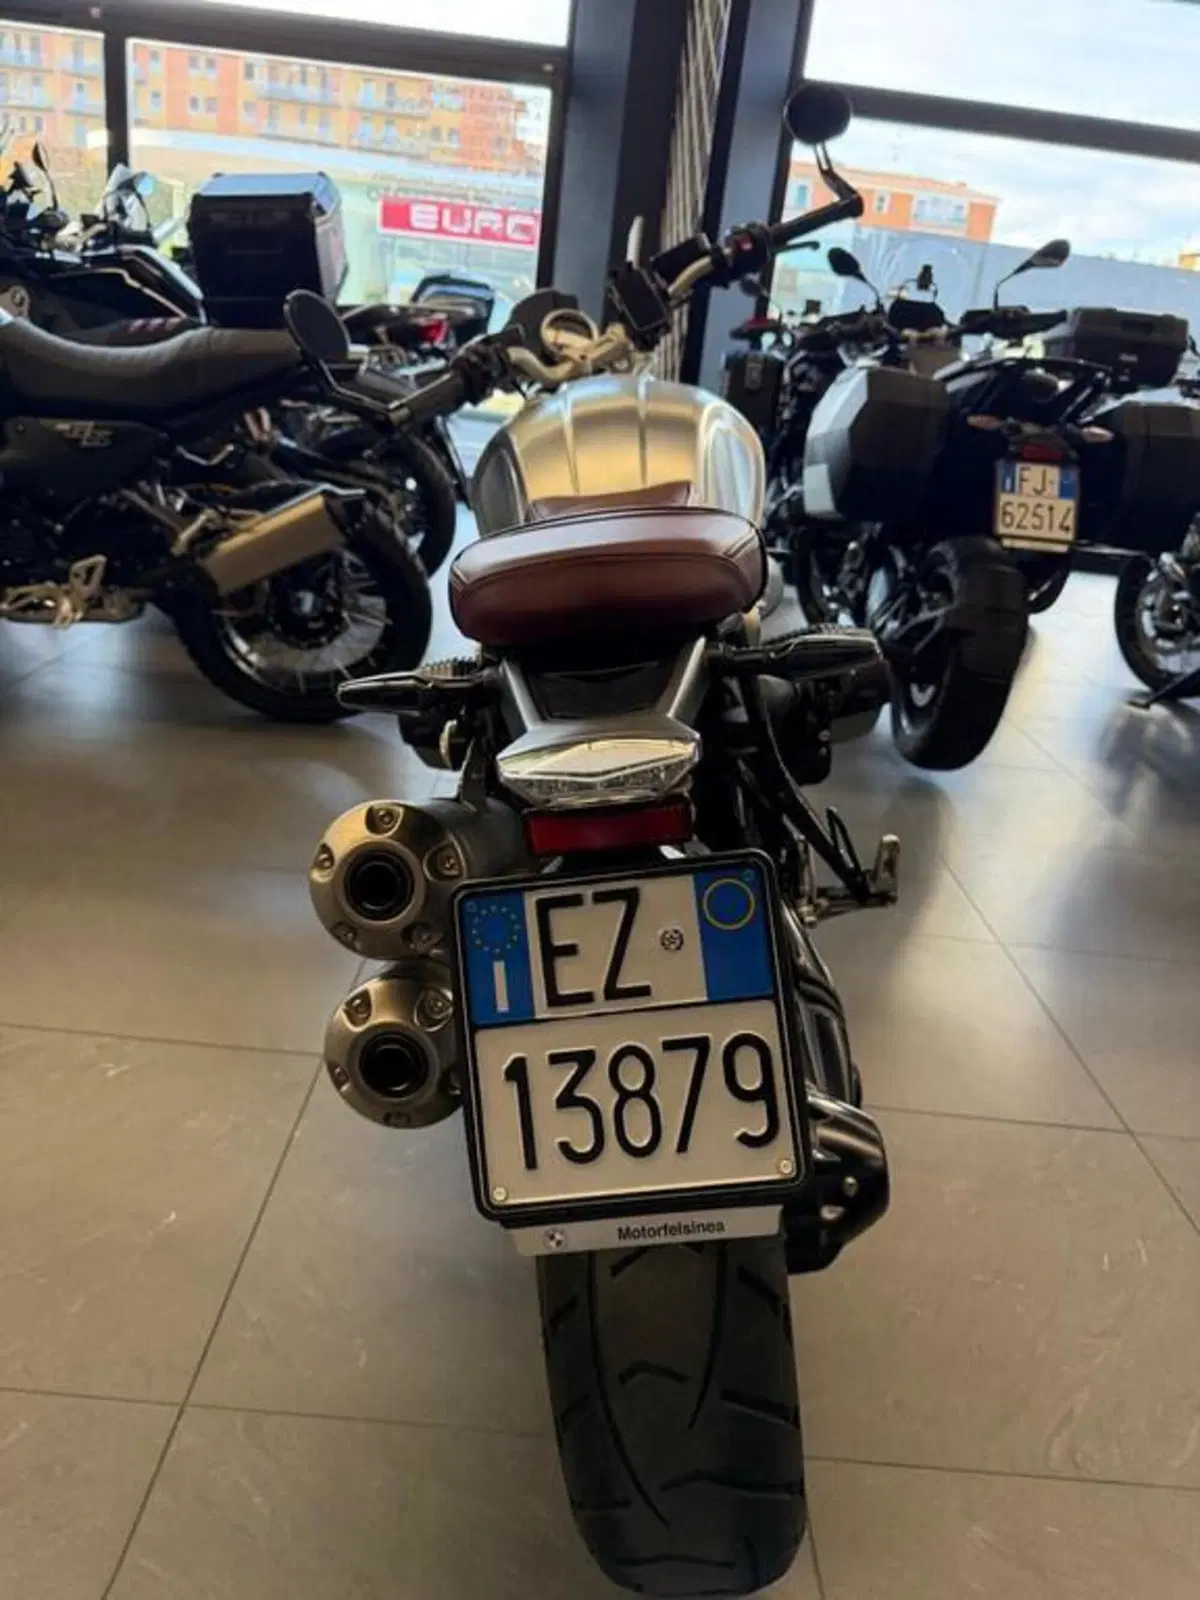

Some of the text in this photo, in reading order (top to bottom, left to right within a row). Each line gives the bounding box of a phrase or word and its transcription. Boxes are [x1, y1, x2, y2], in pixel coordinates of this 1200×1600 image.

[1020, 466, 1047, 496] FJ
[1001, 501, 1073, 533] 62514
[492, 886, 651, 1013] I EZ
[503, 1032, 780, 1170] 13879
[617, 1219, 726, 1241] Motorfelsinea
